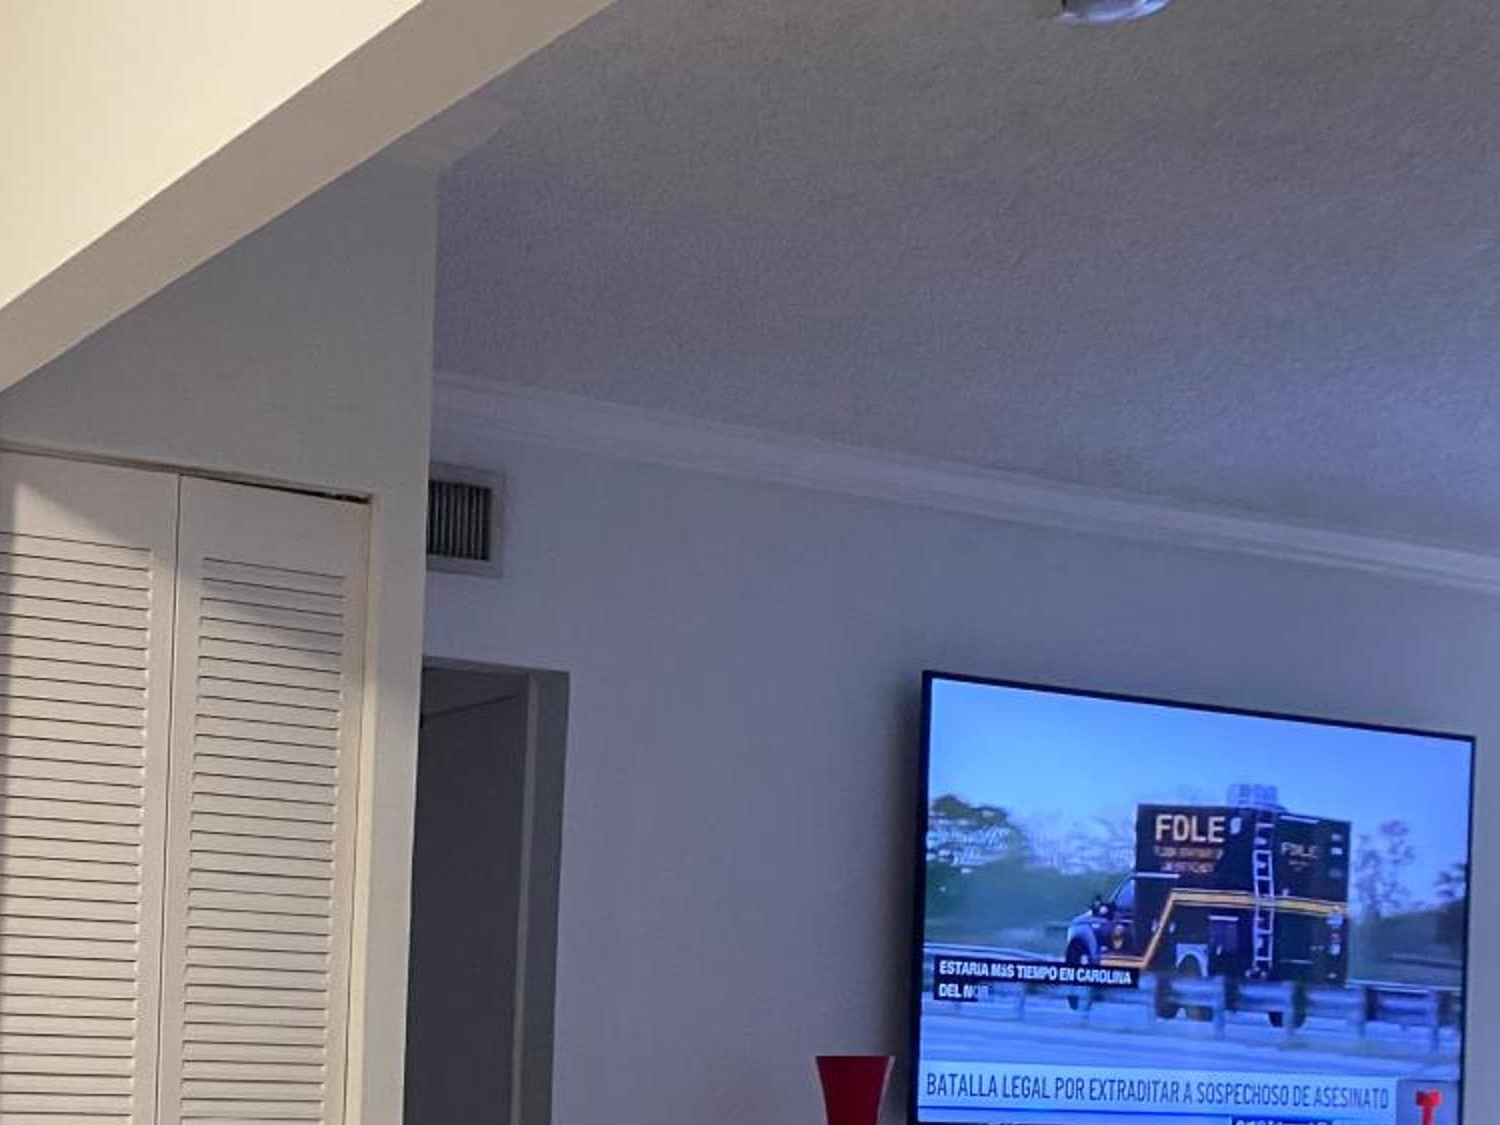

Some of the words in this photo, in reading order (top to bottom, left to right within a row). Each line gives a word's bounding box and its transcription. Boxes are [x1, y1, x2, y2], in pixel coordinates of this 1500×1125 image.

[1155, 813, 1225, 843] FDLE
[1016, 964, 1057, 981] TIEMPO
[1059, 967, 1076, 981] EN
[1076, 968, 1132, 984] CAROLINA
[938, 983, 962, 998] DEL
[926, 1072, 998, 1098] BATALLA
[1002, 1074, 1051, 1099] LEGAL
[1055, 1077, 1085, 1101] POR
[1089, 1078, 1181, 1104] EXTRADITAR
[1183, 1082, 1194, 1104] A
[1197, 1082, 1289, 1106] SOSPECHOSO
[1293, 1086, 1311, 1107] DE
[1313, 1086, 1390, 1110] ASESINATO
